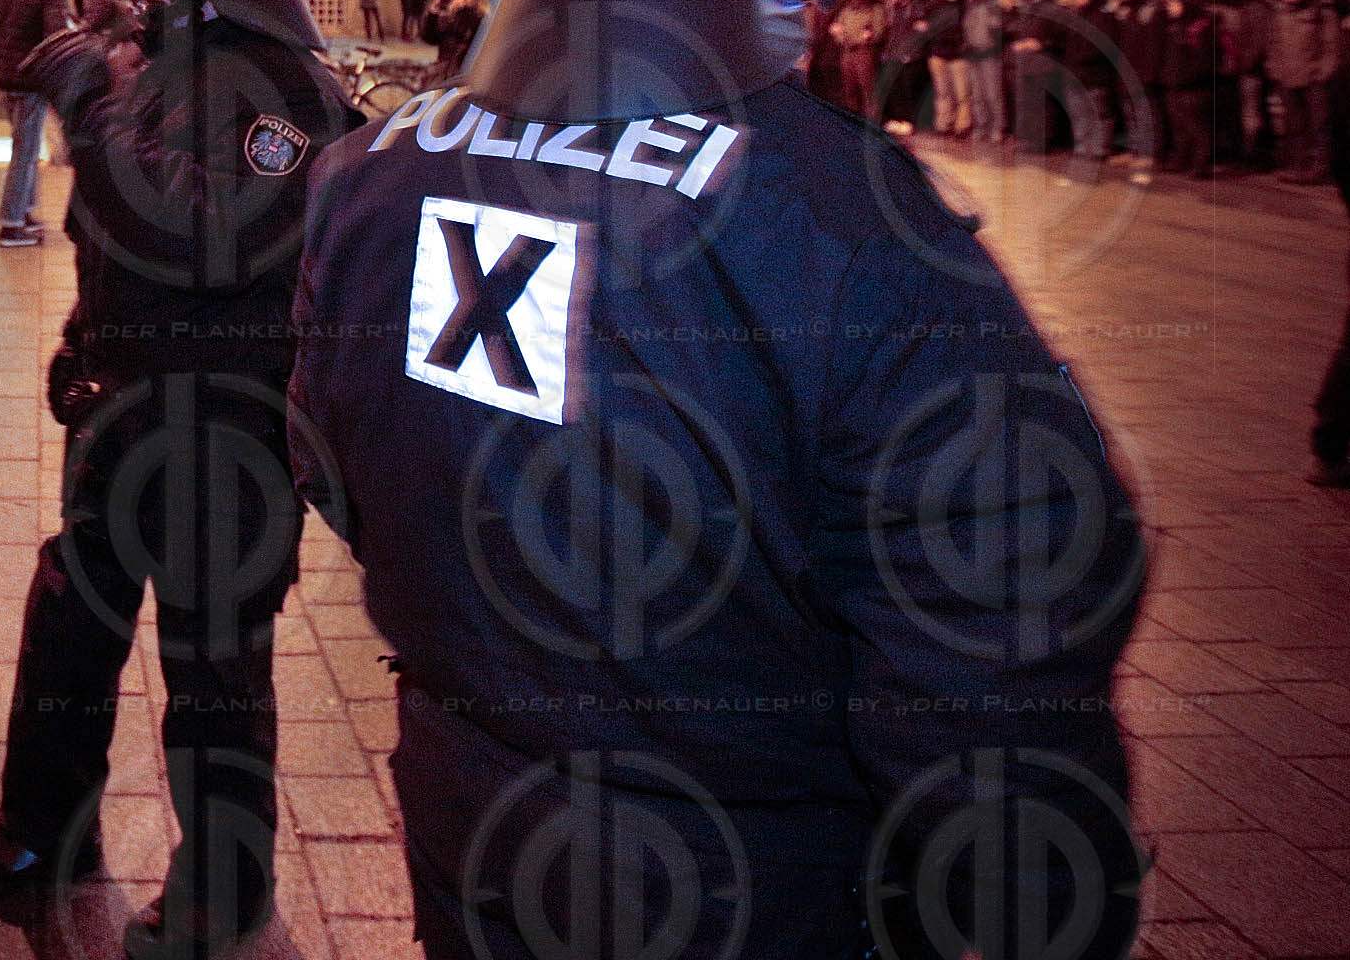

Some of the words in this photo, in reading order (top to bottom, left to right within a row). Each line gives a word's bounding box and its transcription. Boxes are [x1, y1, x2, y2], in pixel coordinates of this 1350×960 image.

[259, 118, 305, 147] POLIZEI
[367, 86, 740, 200] POLIZEI
[423, 218, 558, 398] X
